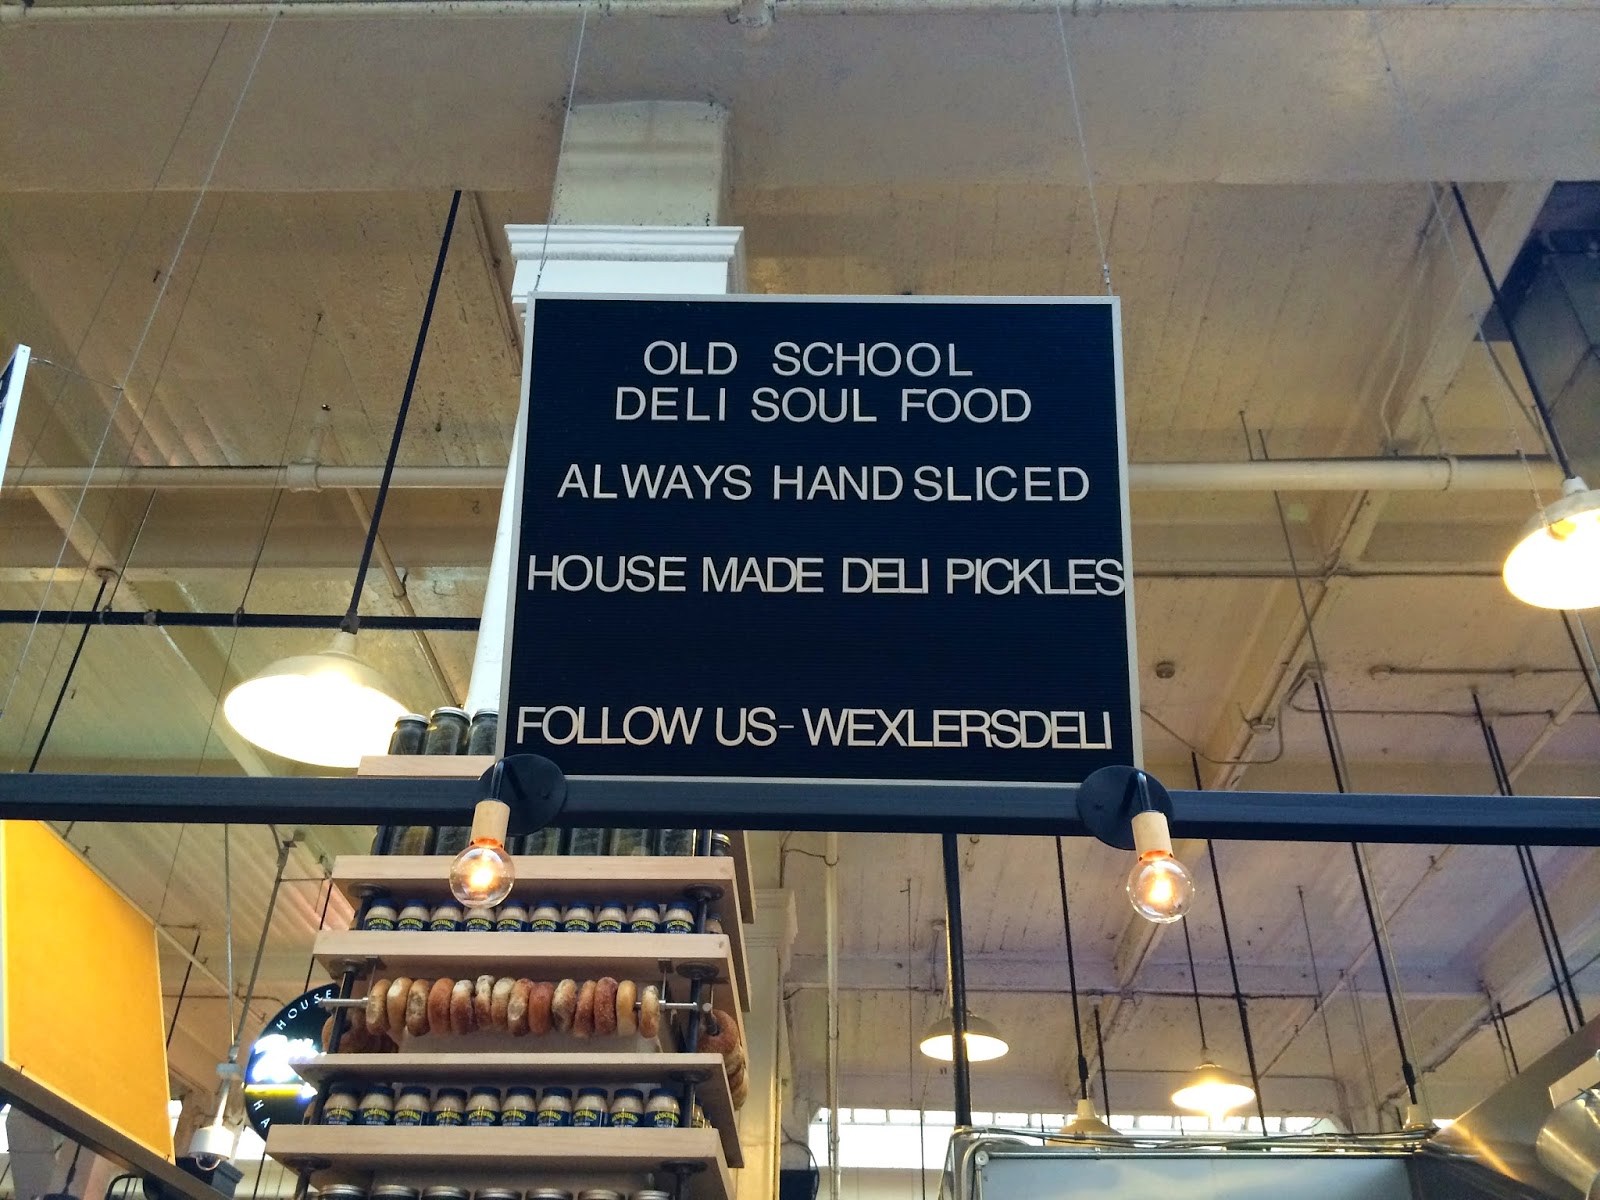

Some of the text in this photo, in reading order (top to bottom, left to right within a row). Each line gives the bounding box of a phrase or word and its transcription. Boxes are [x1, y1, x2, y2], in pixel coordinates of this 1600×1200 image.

[643, 340, 973, 377] OLD SCHOOL
[615, 386, 1032, 423] DELI SOUL FOOD
[557, 464, 1090, 502] ALWAYS HAND SLICED
[527, 554, 1125, 596] HOUSE MADE DELI PICKLES
[516, 705, 704, 746] FOLLOW
[801, 707, 1113, 750] WEXLERSDELI
[276, 989, 332, 1031] HOUSE
